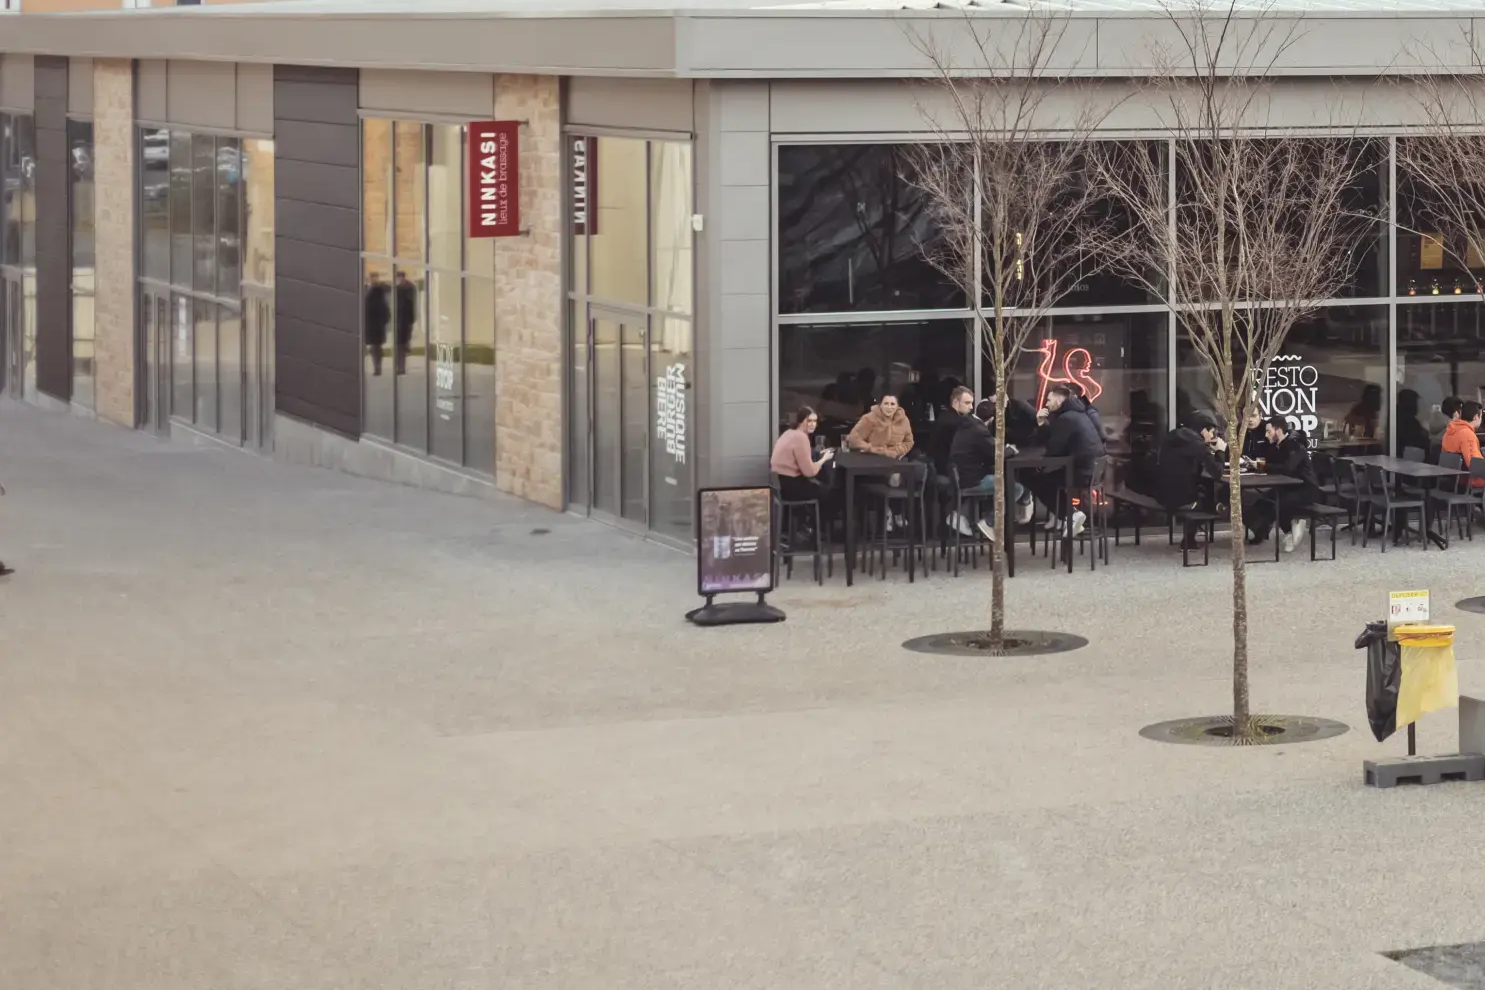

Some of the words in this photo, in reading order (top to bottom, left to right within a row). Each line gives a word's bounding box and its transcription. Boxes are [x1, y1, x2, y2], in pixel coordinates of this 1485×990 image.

[480, 132, 497, 226] NINKASI
[498, 131, 509, 181] brassage
[498, 182, 508, 198] de
[498, 199, 508, 225] lieux
[657, 377, 667, 441] BIERE
[666, 366, 676, 455] BURGER
[675, 363, 686, 465] MUSIQUE
[1252, 387, 1319, 415] NON
